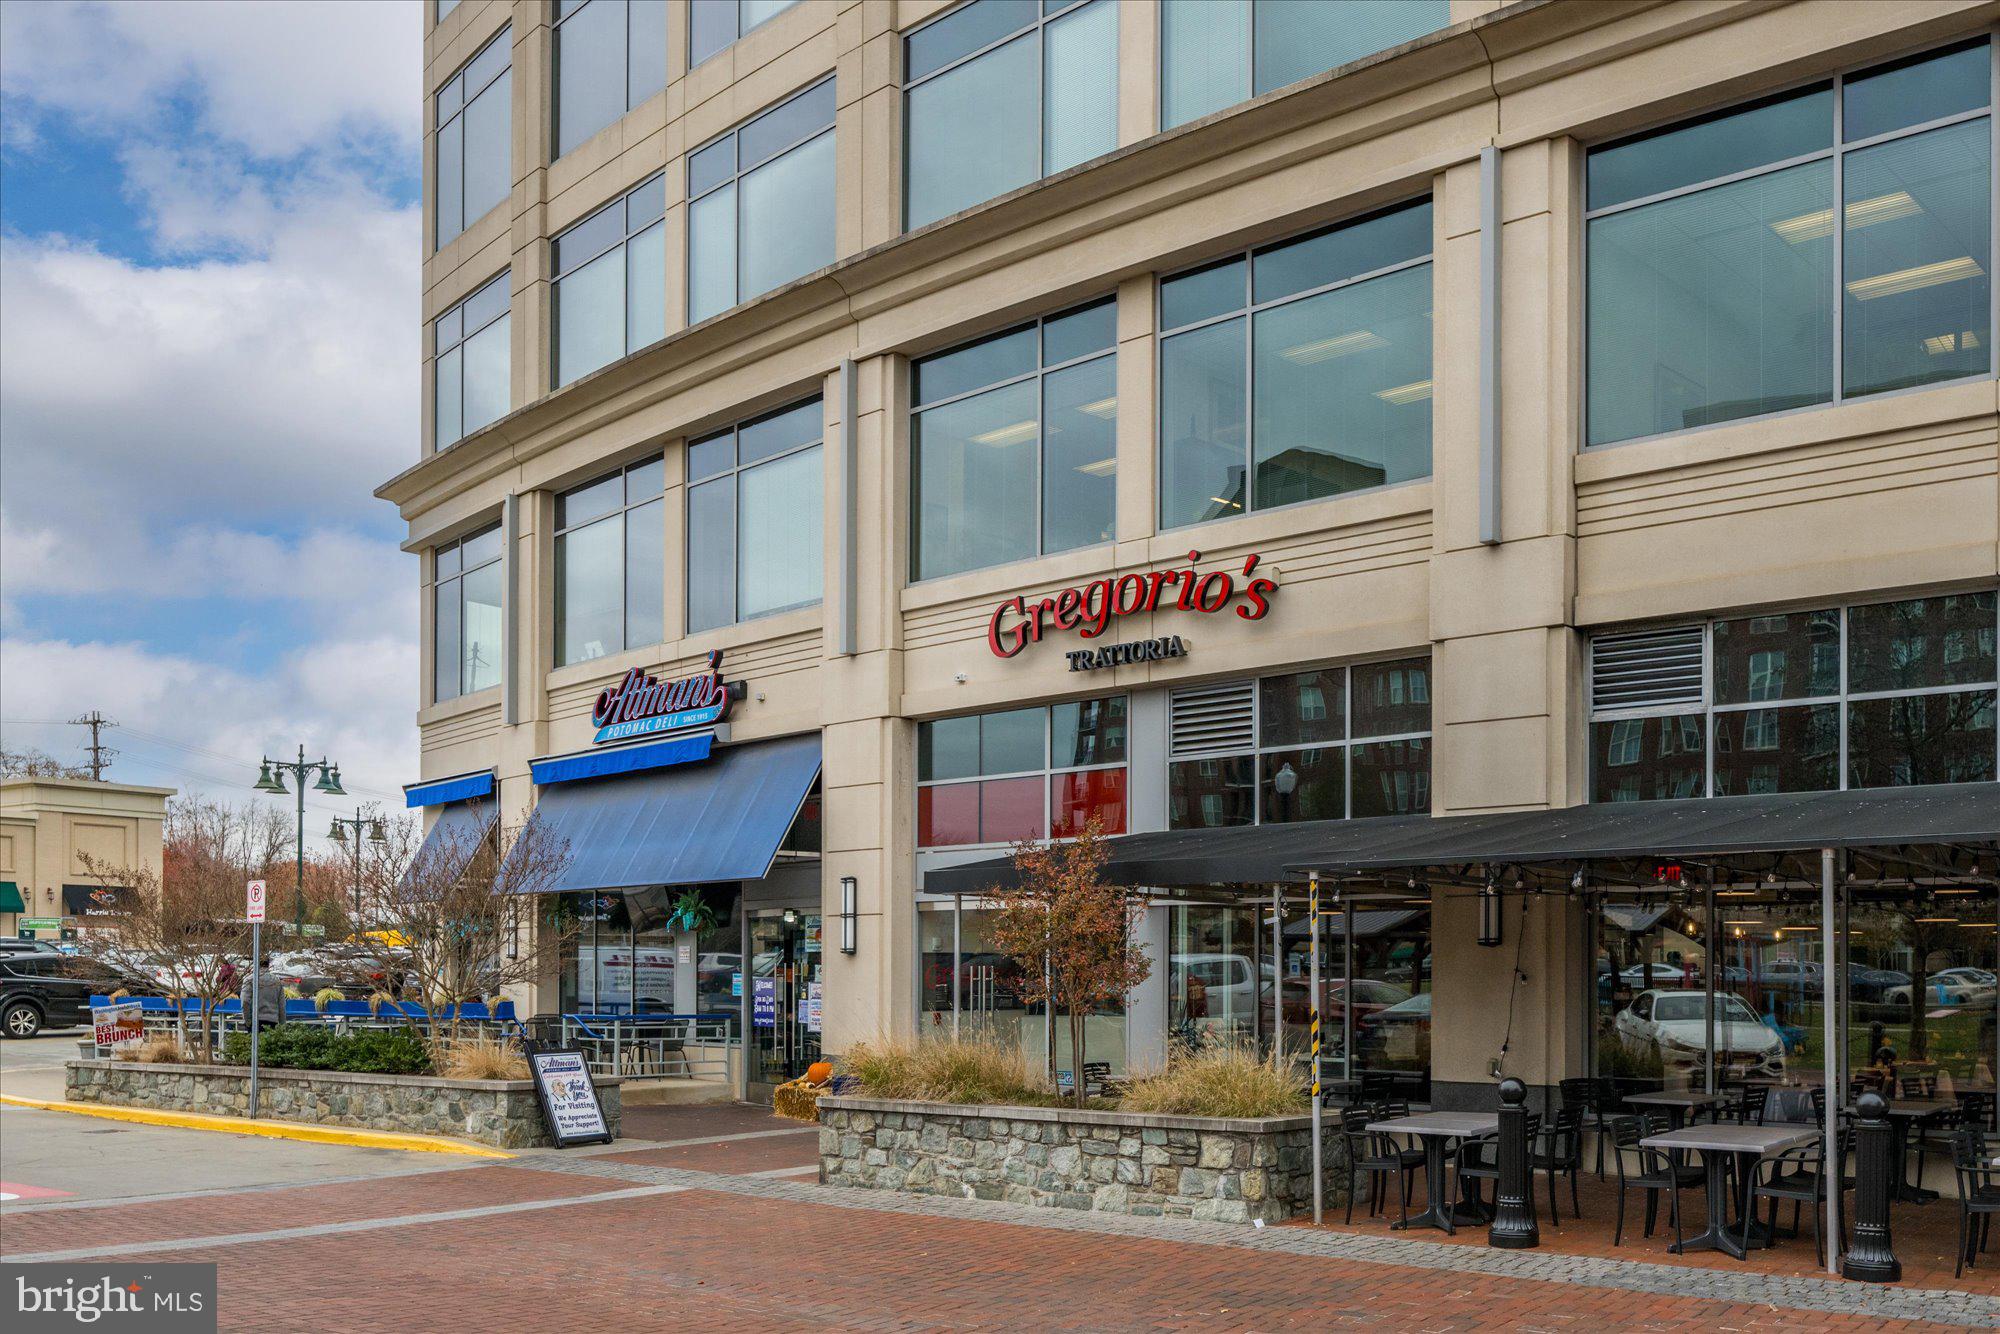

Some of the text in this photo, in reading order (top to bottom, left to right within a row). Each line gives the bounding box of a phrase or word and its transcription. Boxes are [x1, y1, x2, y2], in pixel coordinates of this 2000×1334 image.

[988, 550, 1278, 658] Gregorio's
[1065, 635, 1188, 672] TRATTORIA
[591, 649, 730, 728] Attman's
[607, 720, 652, 738] POTOMAC
[654, 716, 678, 730] DELI
[683, 714, 696, 723] SINCE
[95, 1024, 116, 1034] BEST
[96, 1028, 143, 1045] BRUNCH
[541, 1057, 580, 1069] Attman's
[566, 1079, 590, 1092] Thank
[554, 1102, 595, 1111] For Visiting
[568, 1113, 598, 1121] Appreciate
[576, 1121, 600, 1129] Support!
